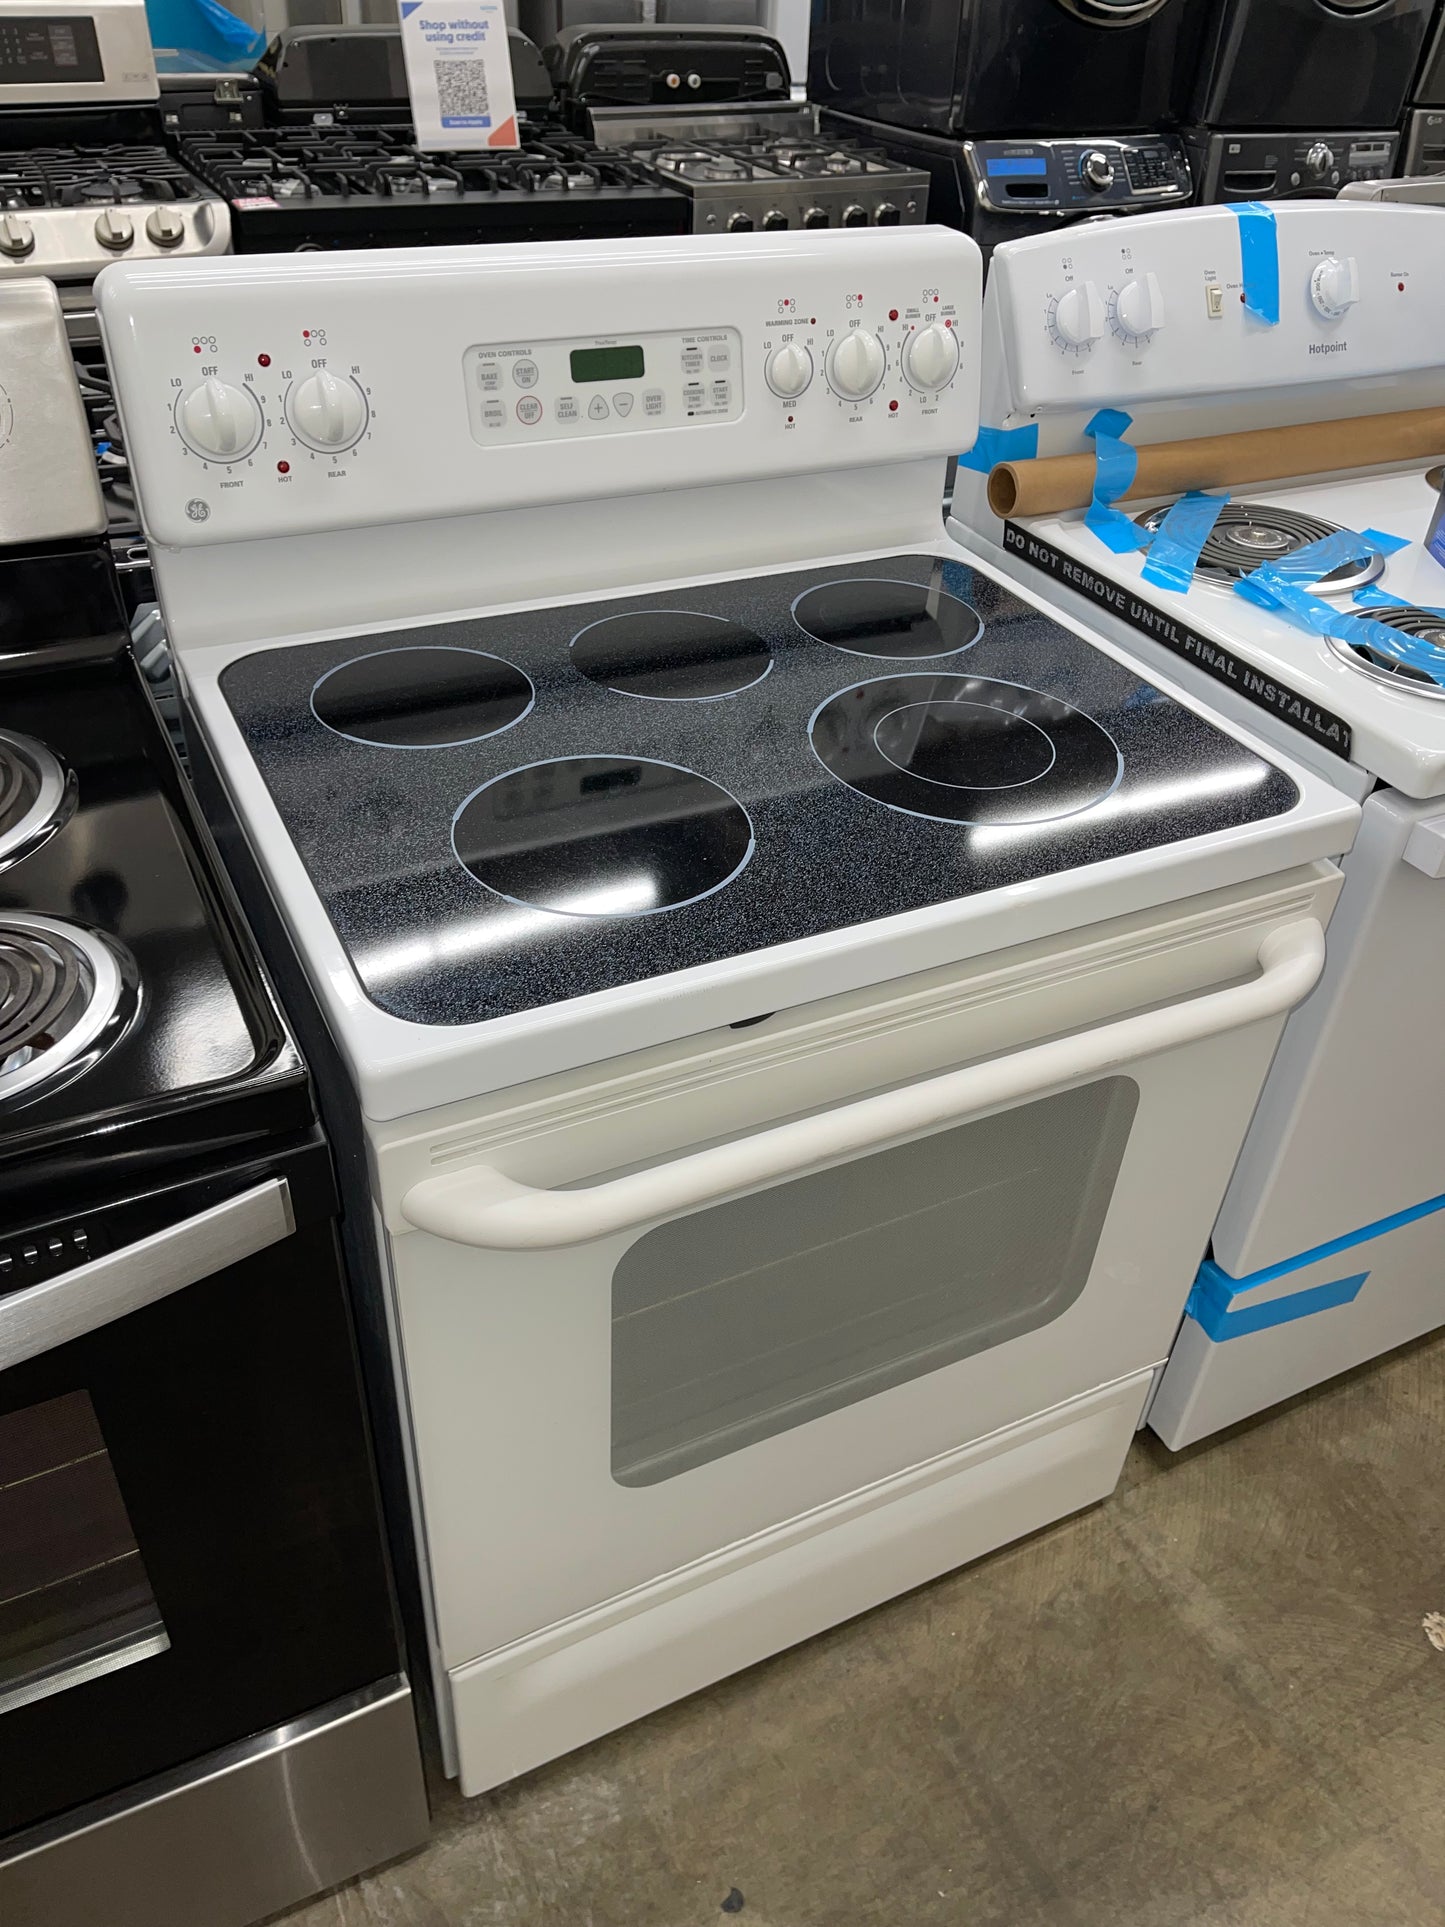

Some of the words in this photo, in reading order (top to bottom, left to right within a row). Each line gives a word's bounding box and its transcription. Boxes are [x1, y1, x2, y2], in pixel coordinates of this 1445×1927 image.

[419, 20, 447, 31] Shop
[448, 19, 489, 30] without
[425, 32, 454, 43] using
[456, 32, 486, 42] credit
[925, 313, 937, 321] OFF
[765, 319, 793, 327] WARMING
[849, 320, 861, 328] OFF
[826, 329, 834, 337] LO
[696, 334, 728, 342] CONTROLS
[782, 334, 794, 342] OFF
[763, 341, 772, 349] LO
[1308, 341, 1348, 355] Hotpoint
[478, 351, 497, 359] OVEN
[498, 349, 532, 358] CONTROLS
[311, 358, 327, 369] OFF
[201, 366, 219, 377] OFF
[351, 366, 360, 374] HI
[515, 367, 535, 375] START
[244, 373, 254, 382] HI
[281, 370, 292, 379] LO
[481, 373, 498, 381] BAKE
[170, 378, 182, 388] LO
[366, 387, 372, 396] 9
[260, 395, 267, 404] 9
[519, 403, 538, 411] CLEAR
[645, 402, 662, 410] LIGHT
[782, 400, 797, 408] MED
[524, 411, 535, 419] OFF
[279, 417, 286, 425] 2
[169, 425, 176, 434] 2
[290, 438, 297, 446] 3
[182, 447, 188, 456] 3
[352, 448, 358, 457] 6
[310, 452, 316, 460] 4
[331, 456, 338, 464] 5
[202, 462, 209, 471] 4
[247, 459, 254, 467] 6
[226, 465, 232, 474] 5
[328, 470, 347, 478] REAR
[277, 475, 292, 483] HOT
[219, 480, 245, 489] FRONT
[1006, 527, 1026, 550] DO
[1028, 543, 1059, 568] NOT
[1062, 560, 1126, 610] REMOVE
[1130, 602, 1180, 644] UNTIL
[1184, 635, 1238, 680] FINAL
